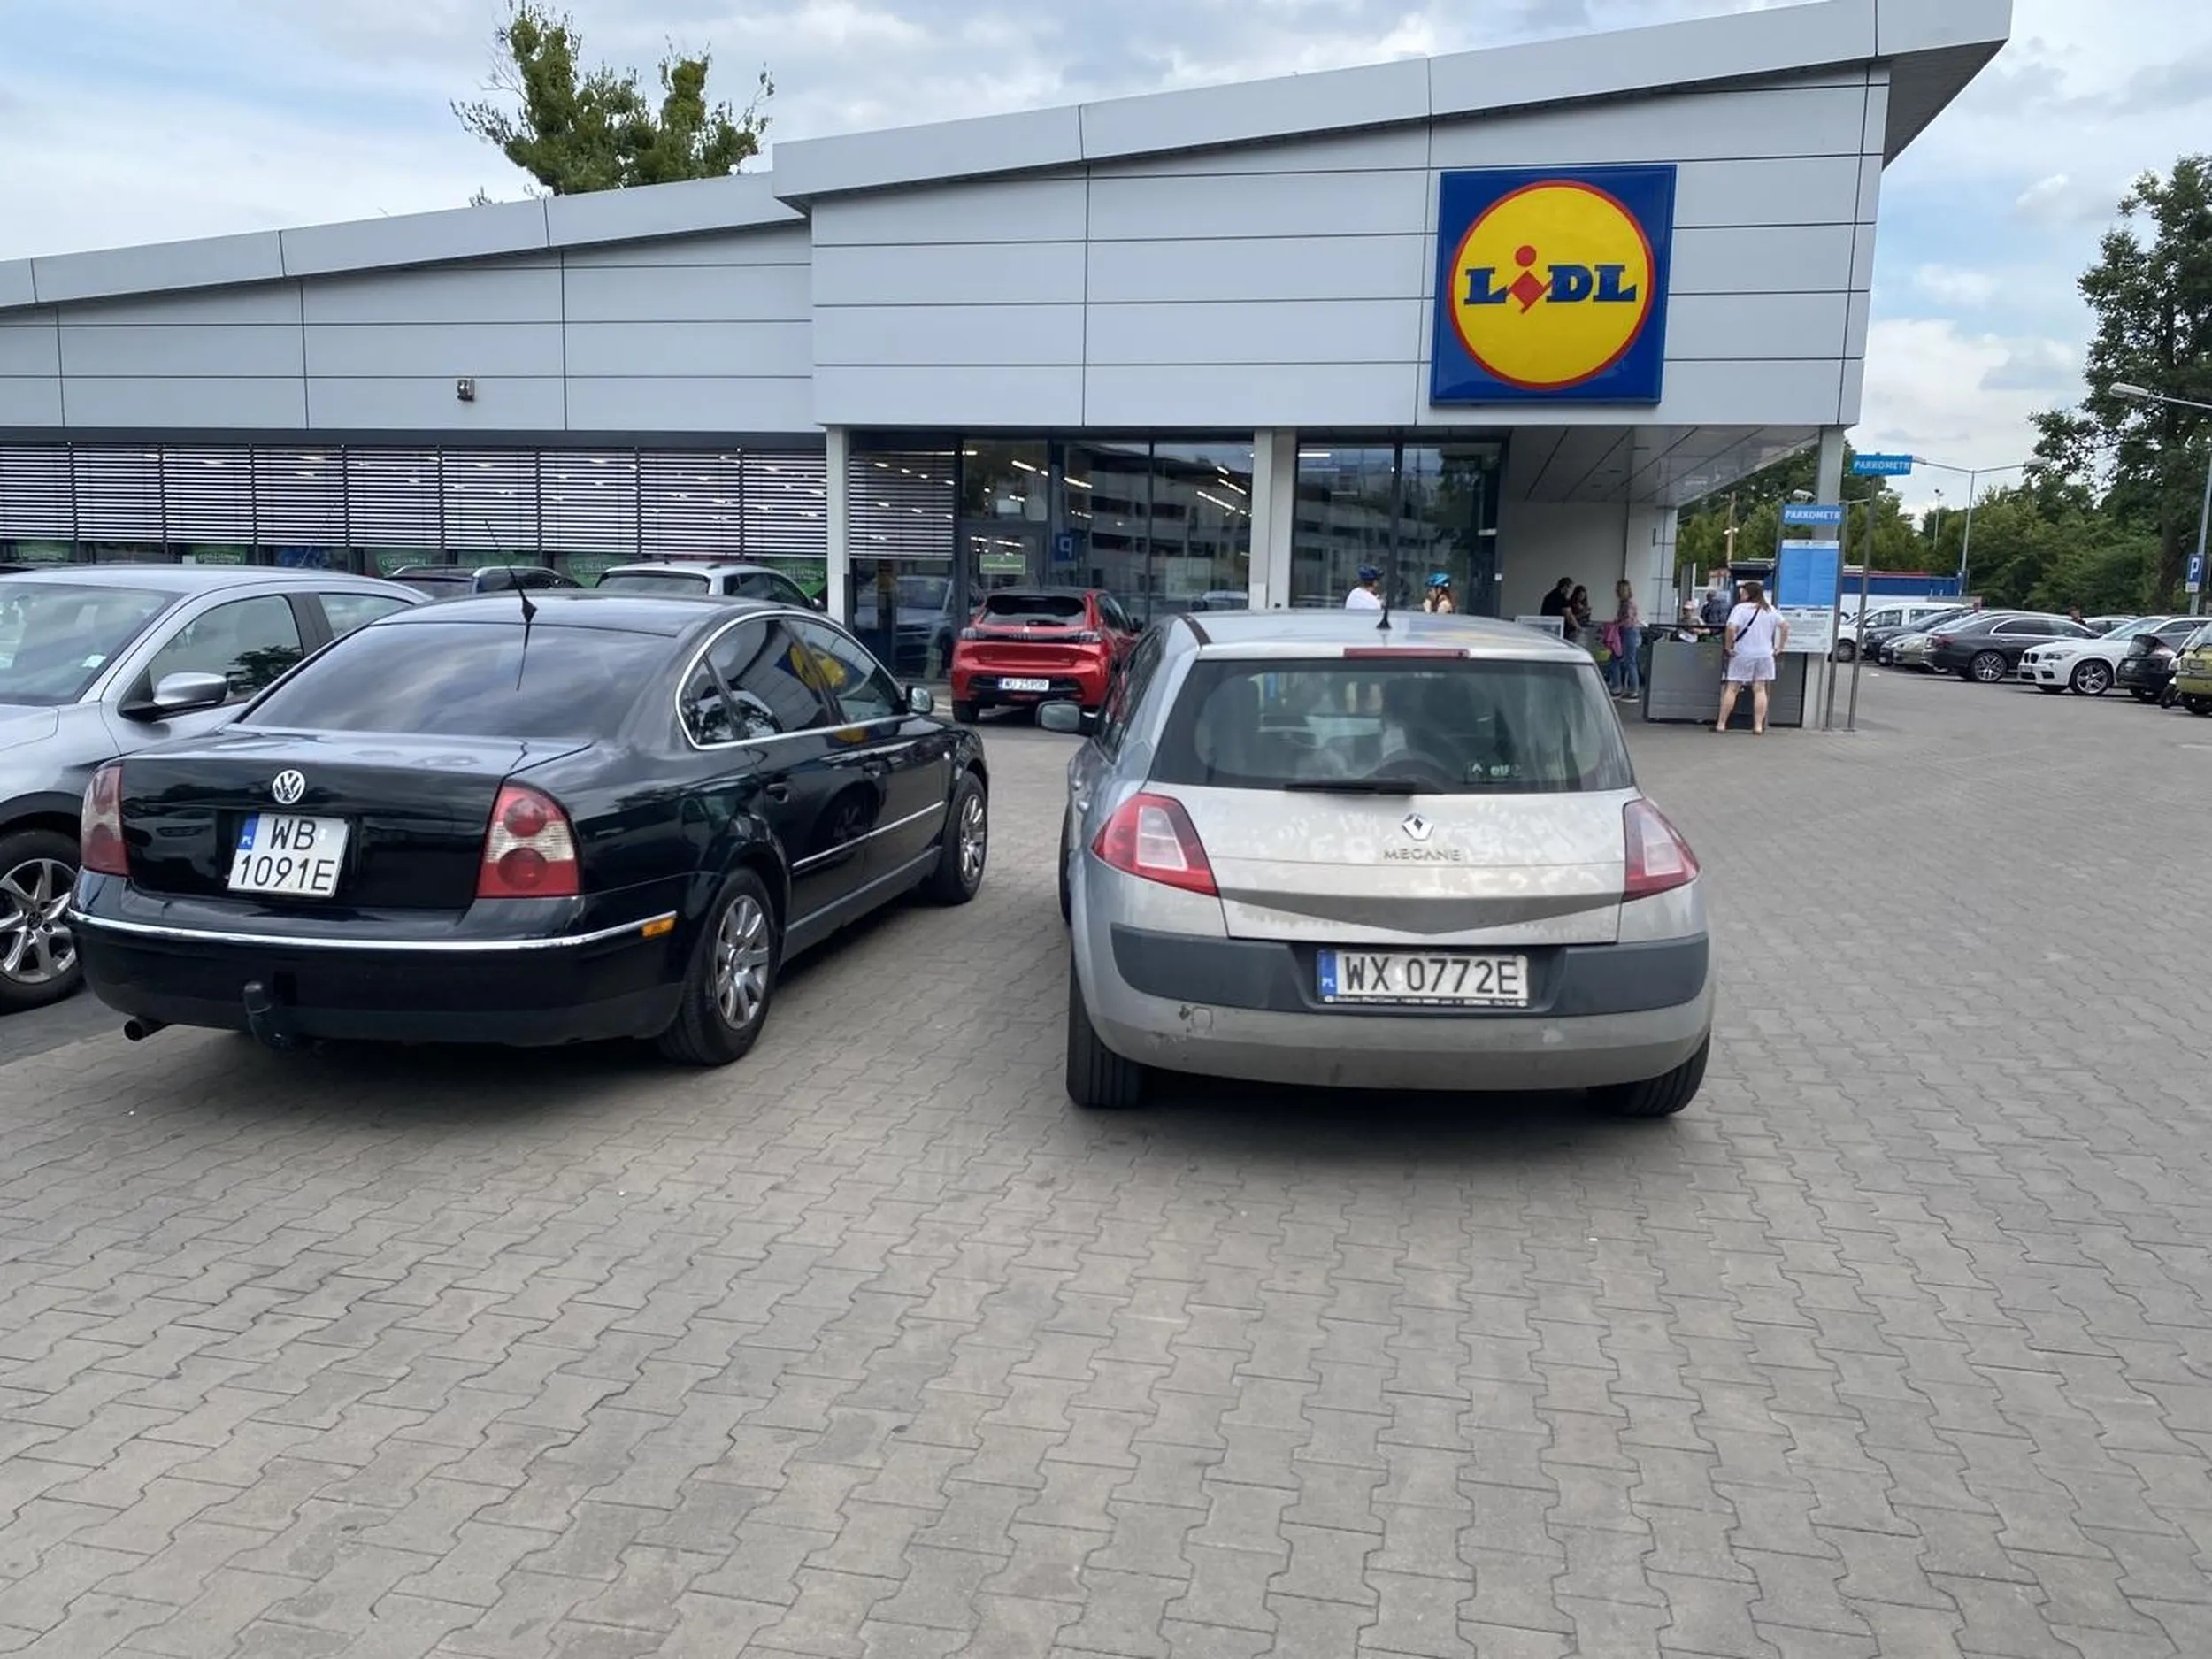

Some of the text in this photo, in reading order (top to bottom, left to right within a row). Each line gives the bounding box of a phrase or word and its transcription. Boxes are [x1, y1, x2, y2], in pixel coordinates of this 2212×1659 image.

[1854, 459, 1910, 472] PARKOMETR
[1785, 509, 1841, 520] PARKOMETR
[2190, 557, 2200, 580] P
[270, 818, 317, 850] WB
[1383, 848, 1463, 861] MEGANE
[241, 854, 334, 891] 1091E
[1345, 956, 1519, 995] WX 0772E
